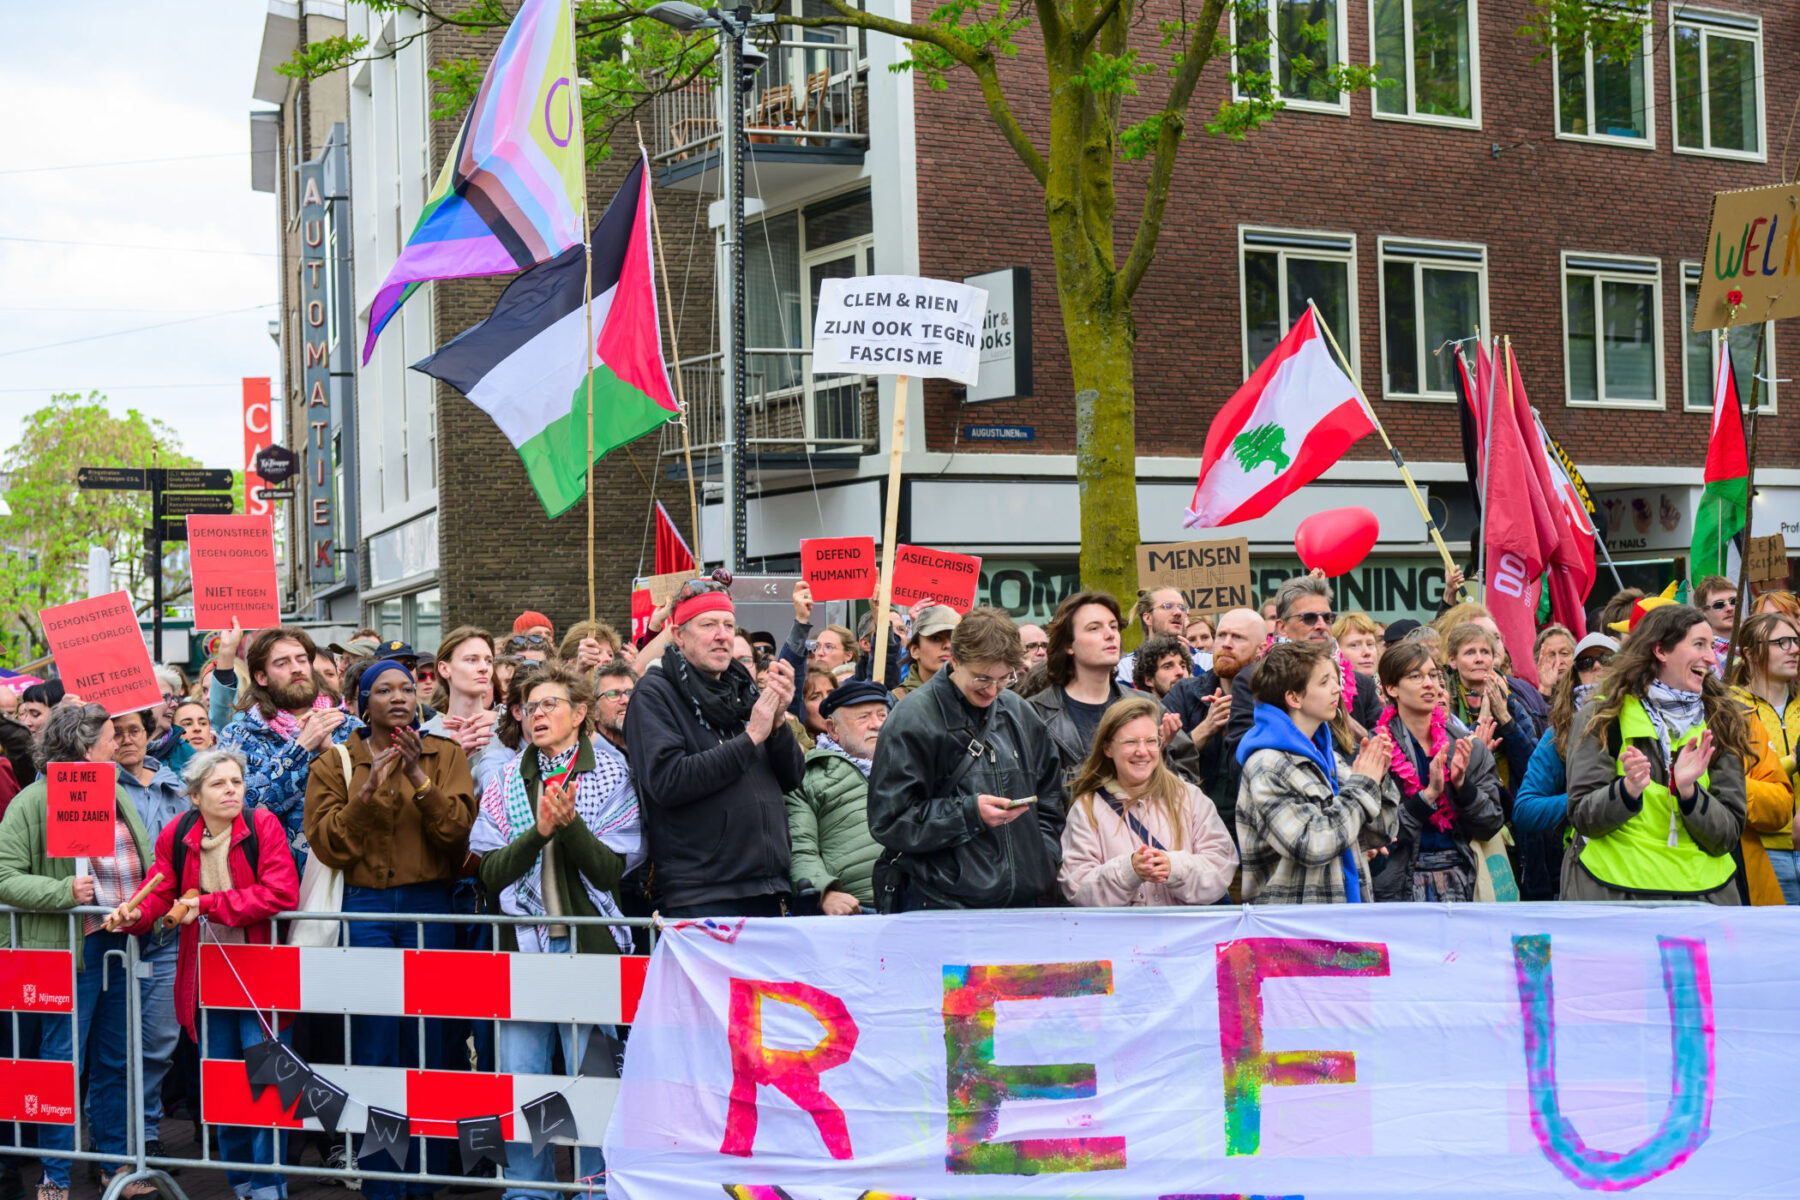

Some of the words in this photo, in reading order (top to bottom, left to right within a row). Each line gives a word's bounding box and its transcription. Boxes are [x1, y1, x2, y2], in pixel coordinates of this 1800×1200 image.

[843, 293, 891, 308] CLEM
[896, 293, 910, 308] &
[915, 295, 958, 313] RIEN
[824, 320, 865, 335] ZIJN
[872, 321, 913, 337] OOK
[921, 323, 975, 348] TEGEN
[850, 345, 943, 365] FASCISME
[303, 177, 332, 568] AUTOMATIEK
[193, 529, 268, 537] DEMONSTREER
[1620, 539, 1647, 549] NAILS
[197, 549, 227, 557] TEGEN
[228, 549, 269, 557] OORLOG
[816, 548, 861, 560] DEFEND
[1148, 546, 1240, 572] MENSEN
[902, 552, 975, 574] ASIELCRISIS
[811, 568, 869, 581] HUMANITY
[205, 586, 233, 597] NIET
[236, 589, 267, 597] TEGEN
[895, 586, 969, 607] BELEIDSCRISIS
[1180, 585, 1246, 609] NZEN
[199, 603, 274, 611] VLUCHTELINGEN
[48, 605, 129, 631] DEMONSTREER
[57, 635, 90, 650] TEGEN
[91, 625, 134, 642] OORLOG
[76, 672, 106, 689] NIET
[109, 665, 142, 681] TEGEN
[79, 679, 152, 702] LUCHTELINGEN
[57, 771, 68, 783] GA
[69, 771, 78, 783] JE
[80, 771, 97, 783] MEE
[69, 791, 87, 802] WAT
[57, 811, 80, 822] MOED
[82, 811, 110, 822] ZAAIEN
[38, 993, 70, 1005] Nijmegen
[41, 1104, 72, 1116] Nijmegen
